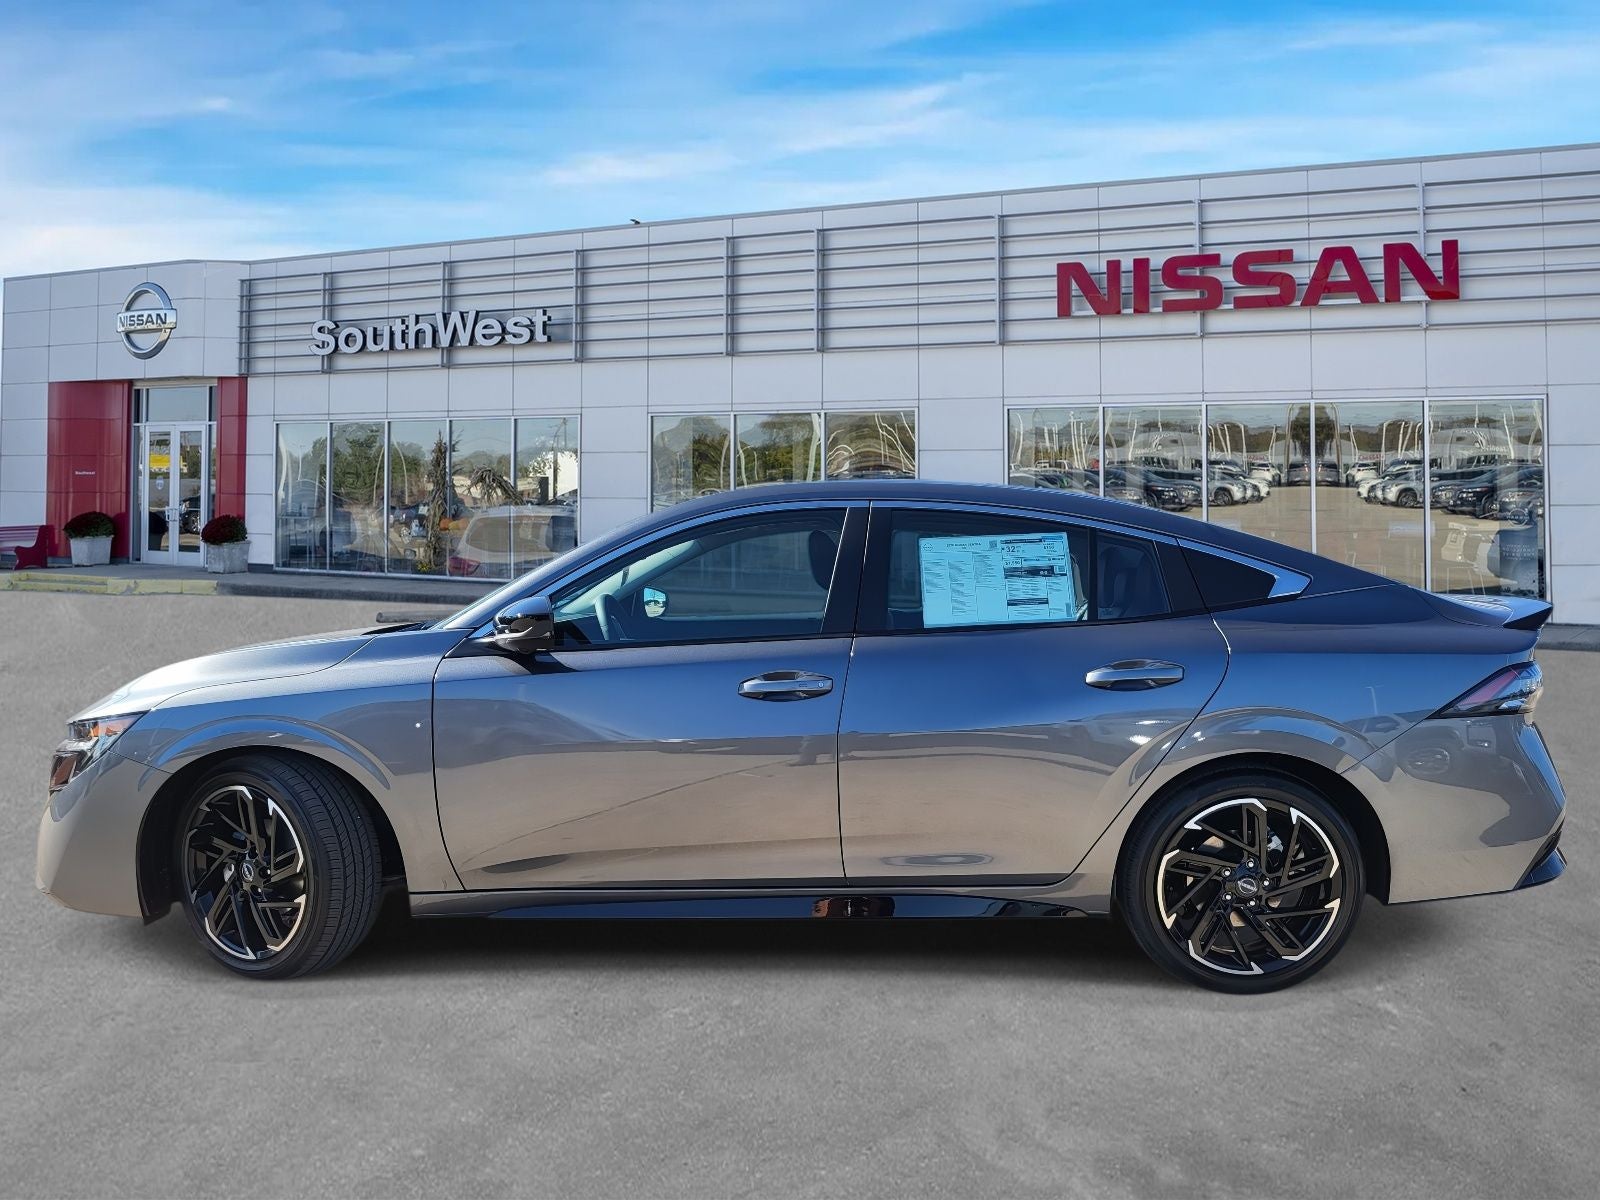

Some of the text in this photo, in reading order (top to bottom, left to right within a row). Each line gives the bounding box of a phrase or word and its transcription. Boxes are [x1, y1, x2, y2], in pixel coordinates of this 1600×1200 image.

[1057, 239, 1460, 318] NISSAN
[119, 313, 167, 328] NISSAN
[309, 308, 551, 356] SouthWest
